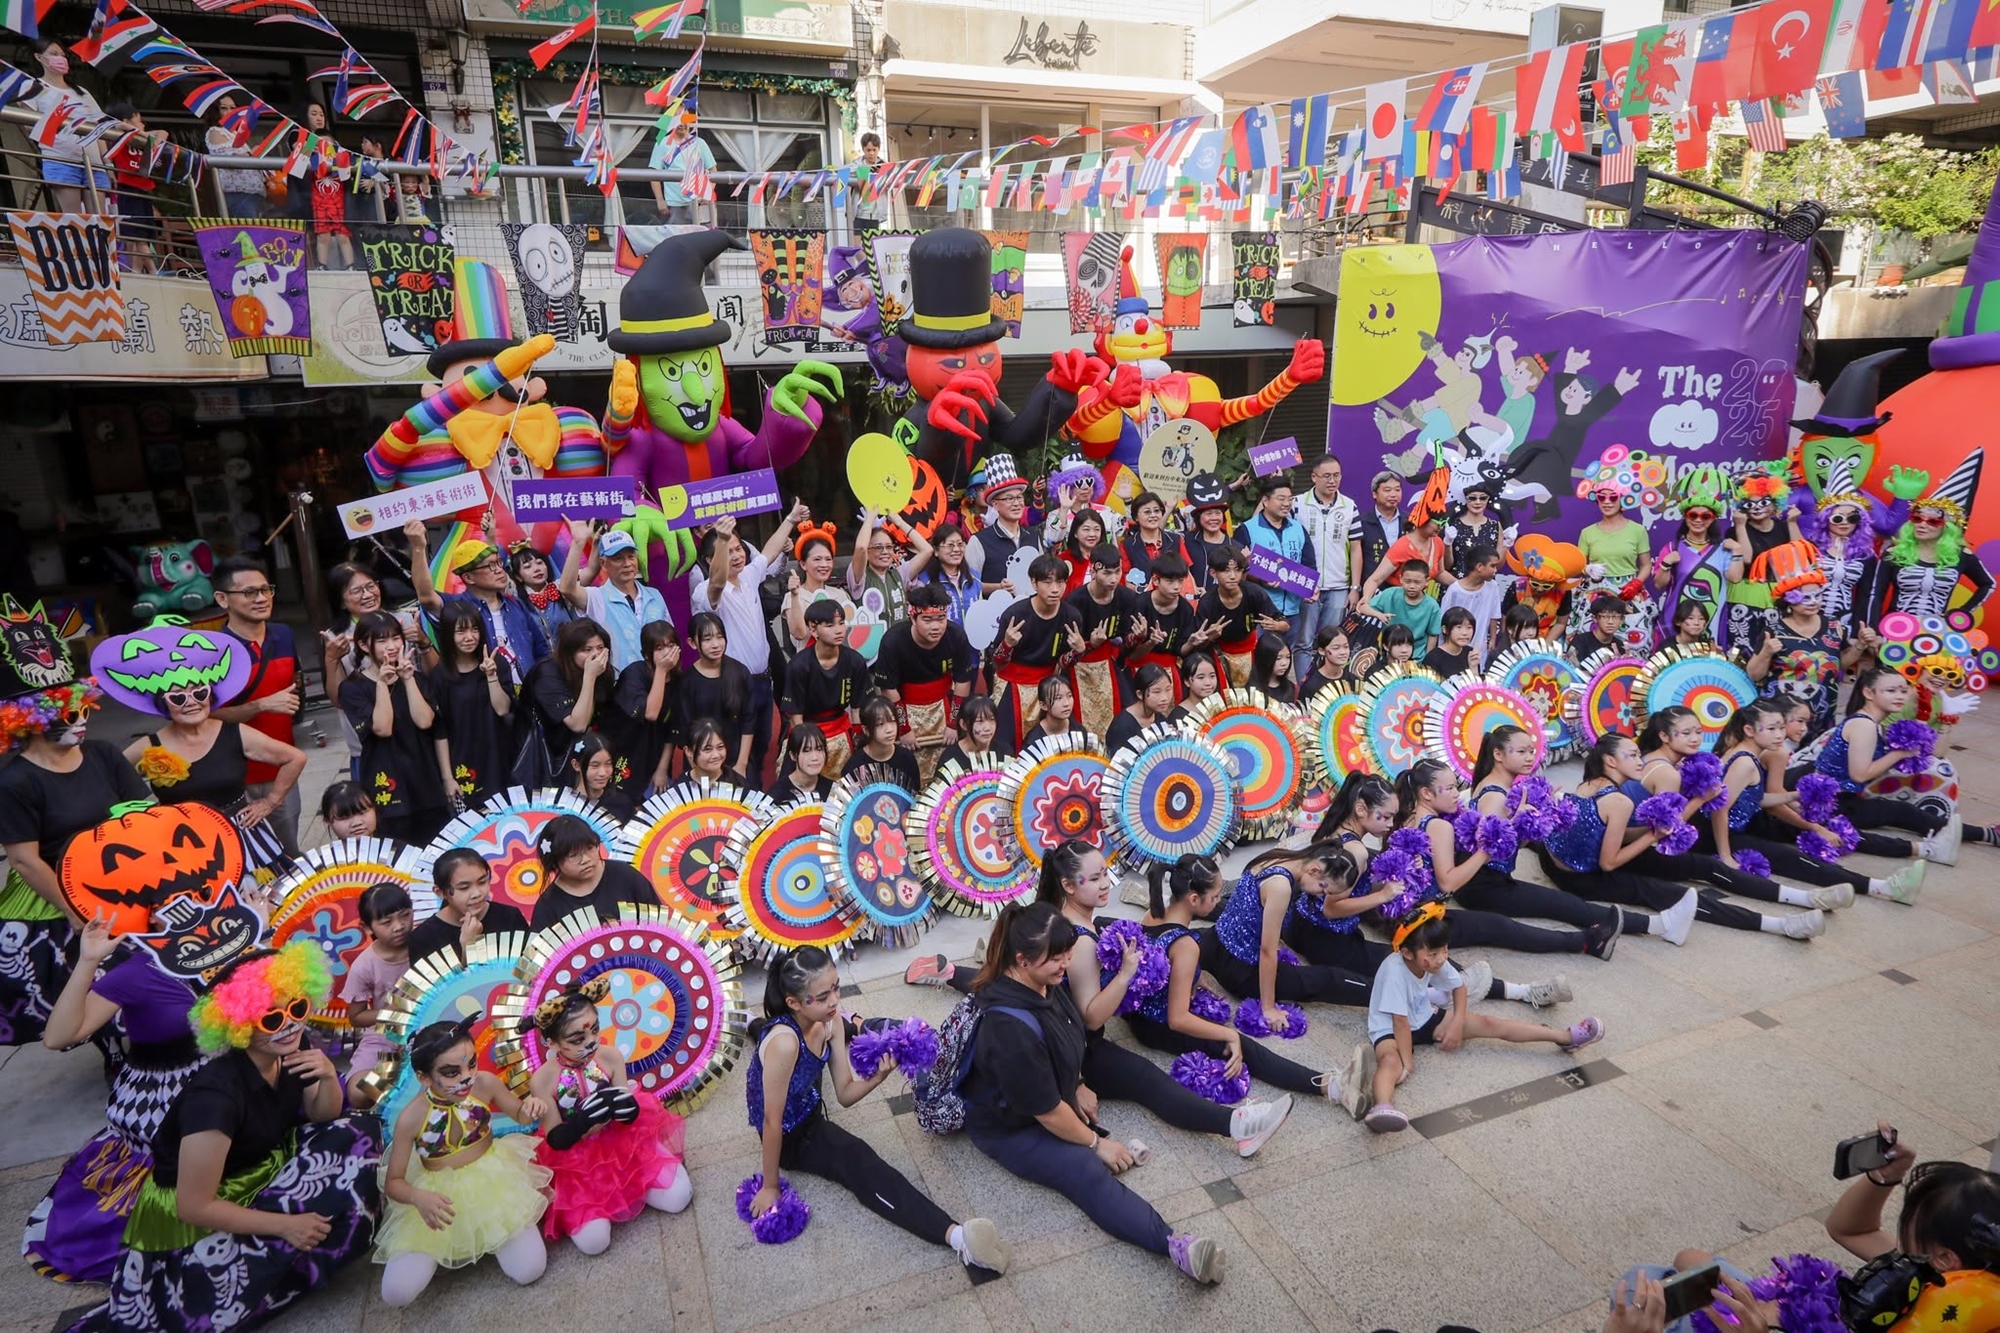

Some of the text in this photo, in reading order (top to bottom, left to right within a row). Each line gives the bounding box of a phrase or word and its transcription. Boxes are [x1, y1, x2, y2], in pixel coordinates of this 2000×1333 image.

[685, 19, 740, 33] uisine
[429, 82, 442, 92] 62
[25, 224, 121, 291] BOO
[362, 240, 455, 273] TRICK
[1235, 244, 1280, 267] TRICK
[407, 275, 425, 290] OR
[766, 328, 796, 343] TRICK
[567, 352, 585, 363] THE
[589, 348, 609, 362] CLAY
[1657, 364, 1724, 401] The
[377, 483, 477, 520] 相約東海藝術街
[516, 490, 625, 510] 我們都在藝術街
